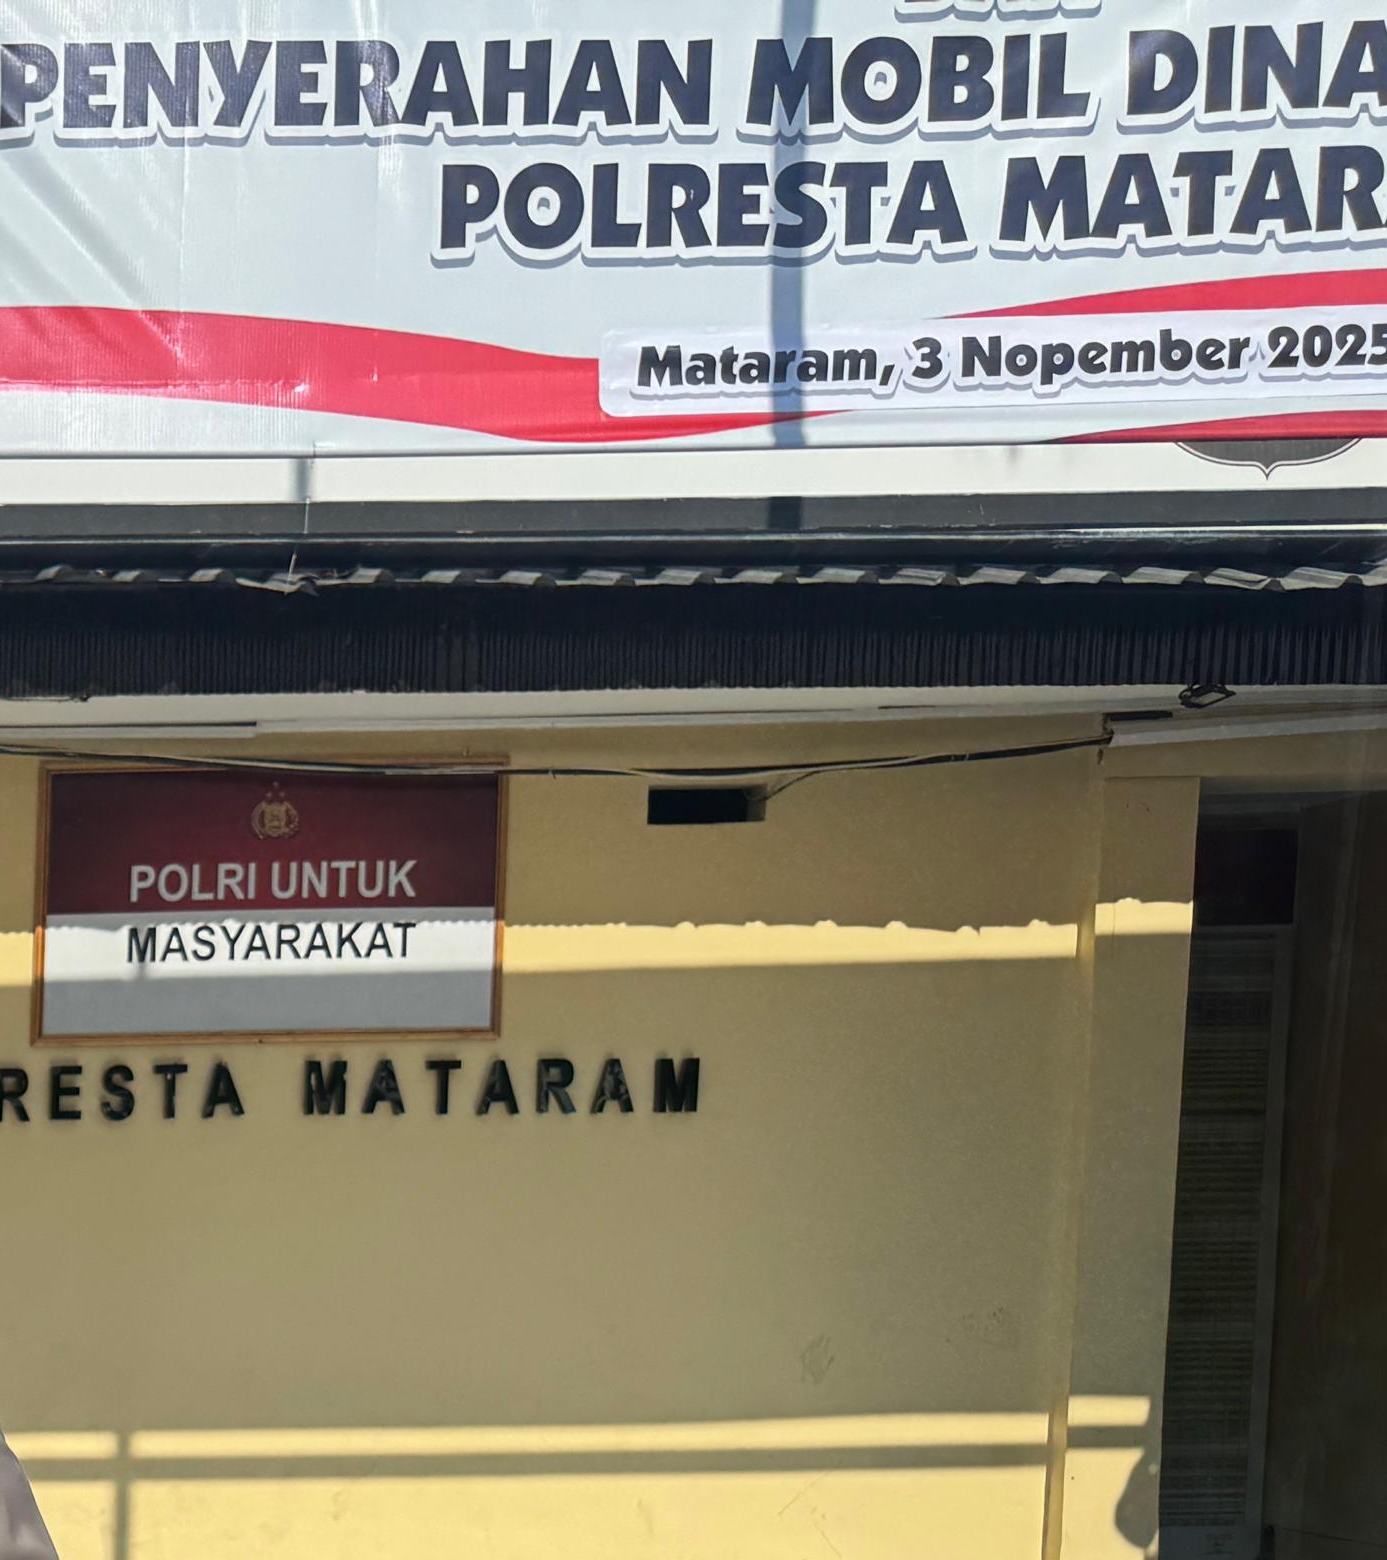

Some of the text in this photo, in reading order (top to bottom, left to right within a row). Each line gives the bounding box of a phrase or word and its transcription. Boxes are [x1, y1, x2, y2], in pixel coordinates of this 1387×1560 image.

[0, 38, 715, 130] PENYERAHAN
[745, 32, 1091, 127] MOBIL
[439, 144, 1387, 251] POLRESTA MATAR
[637, 323, 1387, 387] Mataram, 3 Nopember 2025
[129, 859, 418, 904] POLRI UNTUK
[125, 922, 417, 965] MASYARAKAT
[303, 1057, 702, 1116] MATARAM
